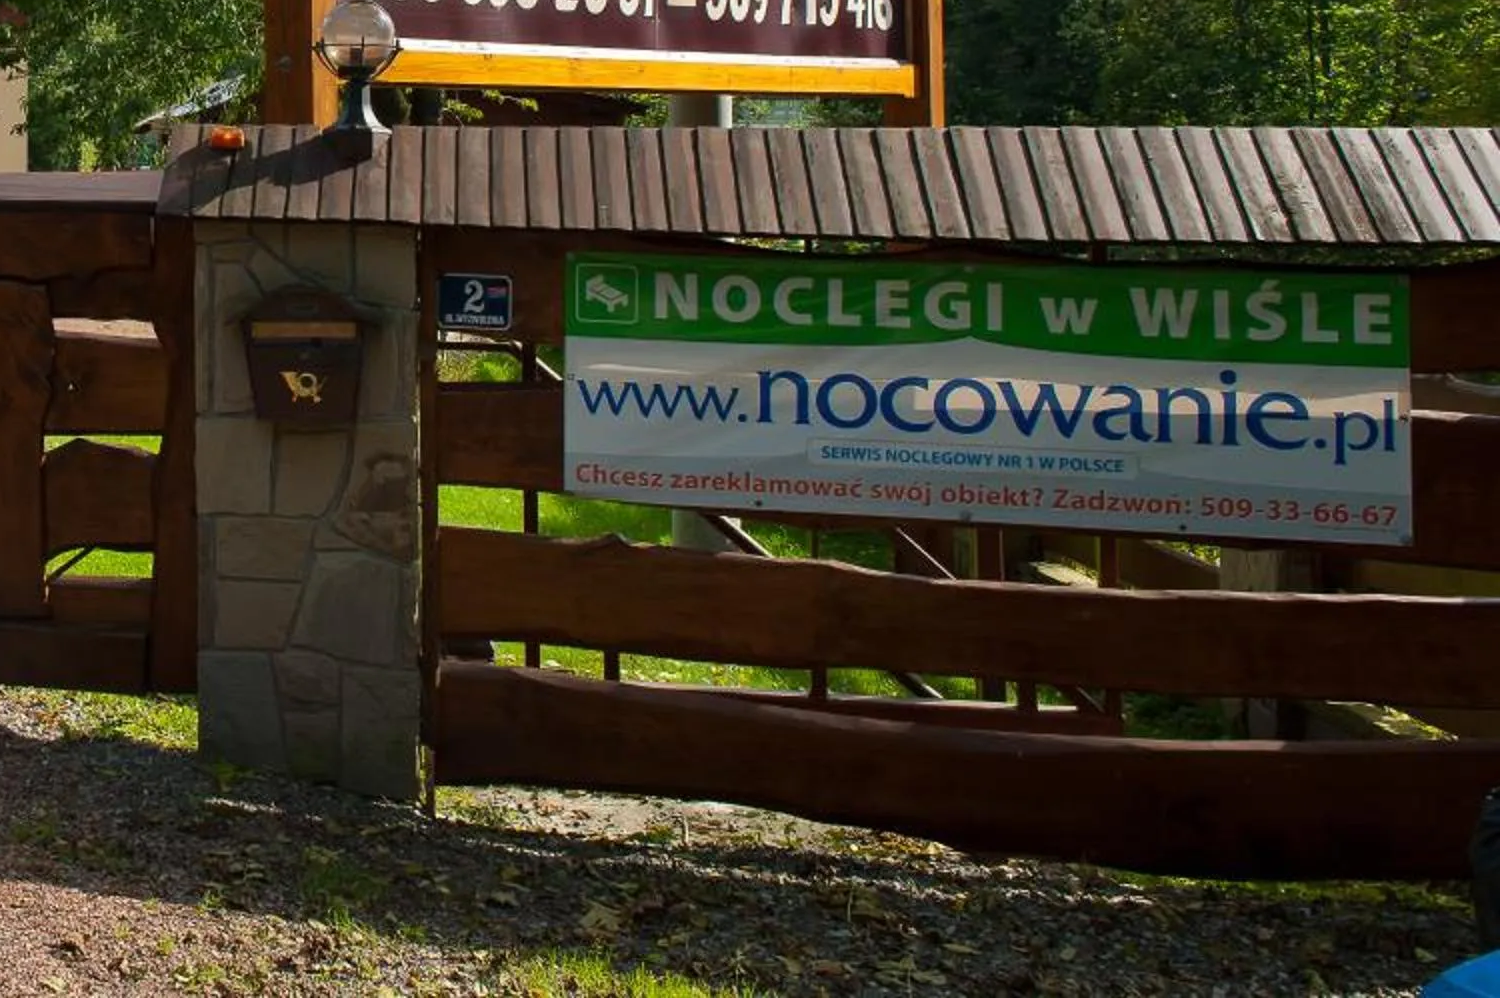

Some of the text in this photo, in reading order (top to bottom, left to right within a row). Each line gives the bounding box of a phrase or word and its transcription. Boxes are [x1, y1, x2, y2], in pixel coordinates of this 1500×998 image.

[463, 279, 485, 314] 2
[654, 271, 1392, 345] NOCLEGI w WIŚLE
[577, 368, 1397, 466] www.nocowanie.pl
[821, 445, 1124, 473] SERWIS NOCLEGOWY NR 1 W POLSCE
[576, 463, 1398, 526] Chcesz zareklamować swój obiekt? Zadzwoń: 509-33-66-67
